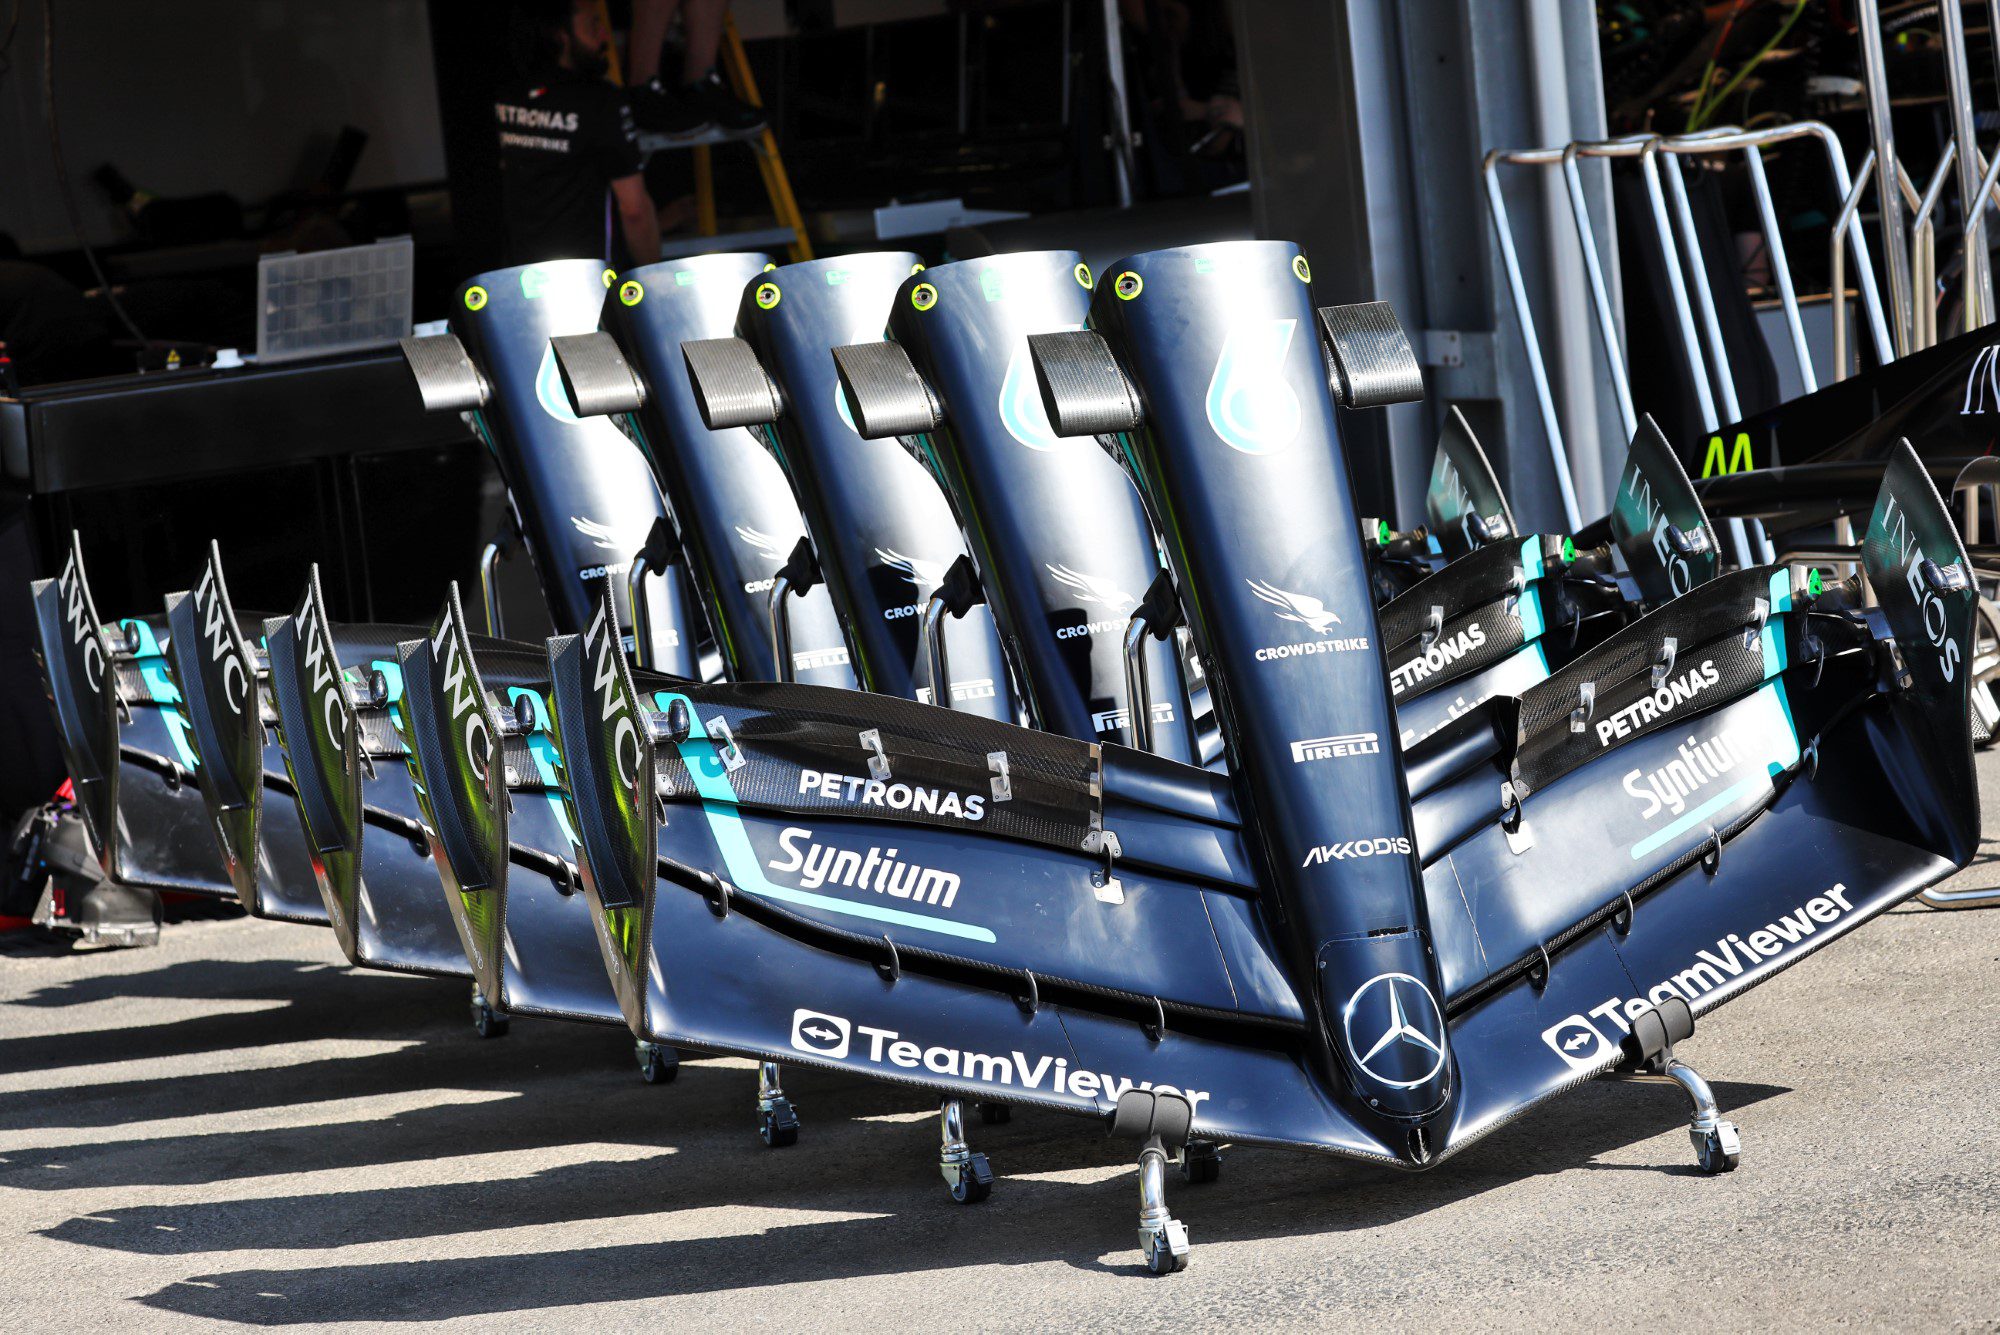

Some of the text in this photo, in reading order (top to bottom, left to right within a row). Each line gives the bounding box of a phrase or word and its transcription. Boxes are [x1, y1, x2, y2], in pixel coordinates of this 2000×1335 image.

[58, 547, 105, 693] IWC
[194, 558, 249, 715] IWC
[1880, 493, 1961, 684] INEOS
[295, 583, 348, 751] IWC
[432, 602, 494, 781] IWC
[583, 594, 644, 790] IWC
[1255, 637, 1370, 662] CROWDSTRIKE
[1390, 623, 1486, 696] ETRONAS
[1595, 660, 1720, 747] PETRONAS
[798, 769, 986, 821] PETRONAS
[1290, 732, 1380, 763] PIRELLI
[768, 826, 961, 908] Syntium
